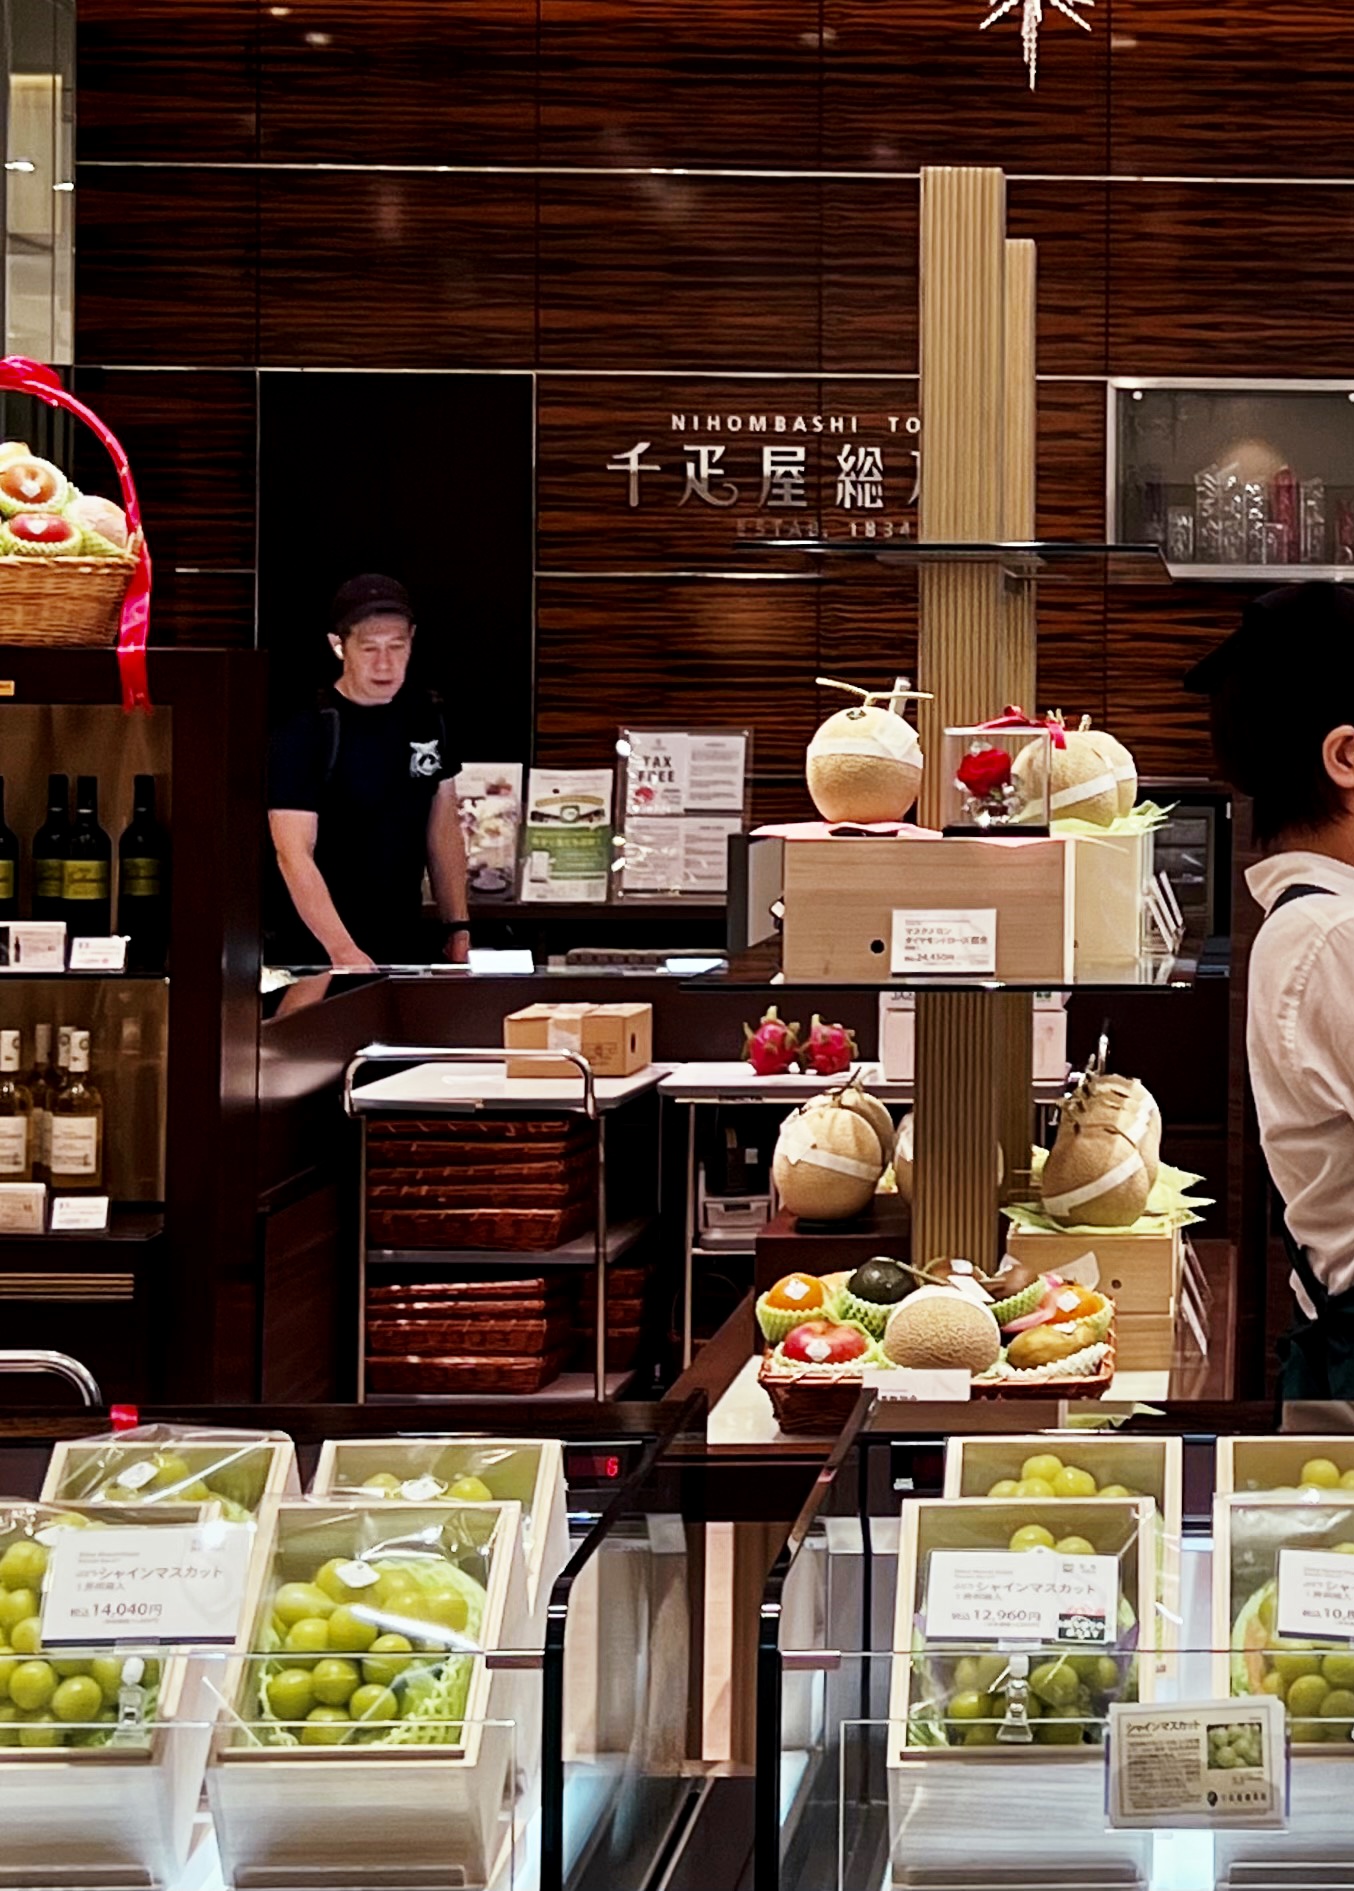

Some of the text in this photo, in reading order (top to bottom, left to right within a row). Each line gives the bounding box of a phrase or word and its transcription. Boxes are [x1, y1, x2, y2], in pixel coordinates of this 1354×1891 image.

[671, 414, 858, 433] NIHOMBASHI
[606, 441, 921, 509] 千疋屋総
[850, 521, 911, 538] 1834
[643, 756, 672, 769] TAX
[98, 1566, 224, 1580] シャインマスカット
[976, 1581, 1096, 1594] シャインマスカット
[92, 1603, 163, 1617] 14,040円
[973, 1609, 1042, 1622] 12,960円
